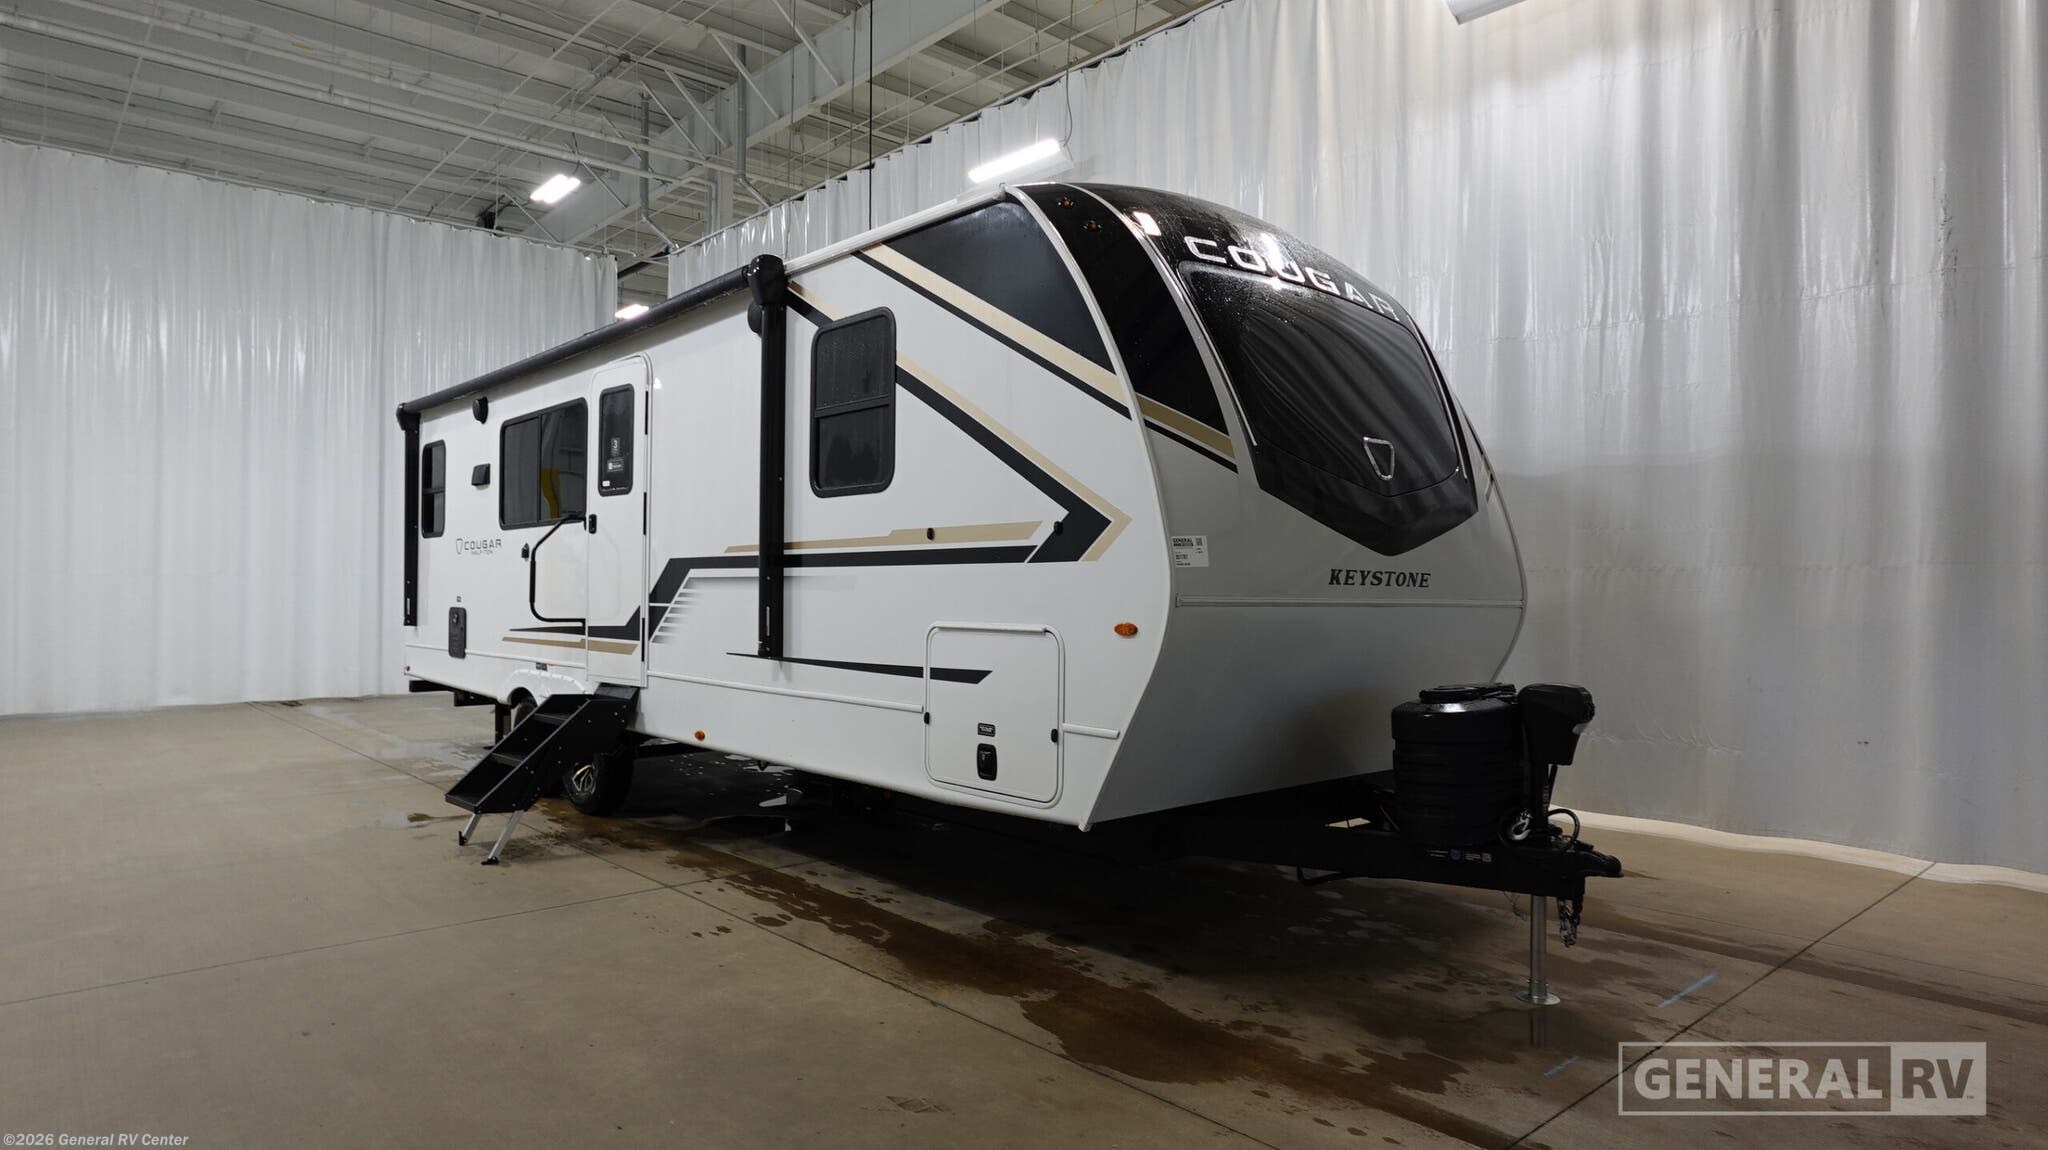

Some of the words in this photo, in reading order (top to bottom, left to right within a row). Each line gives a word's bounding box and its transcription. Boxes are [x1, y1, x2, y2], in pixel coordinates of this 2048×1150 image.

[1184, 235, 1400, 321] COUGAR
[464, 538, 502, 551] COUGAR
[1328, 568, 1432, 588] KEYSTONE
